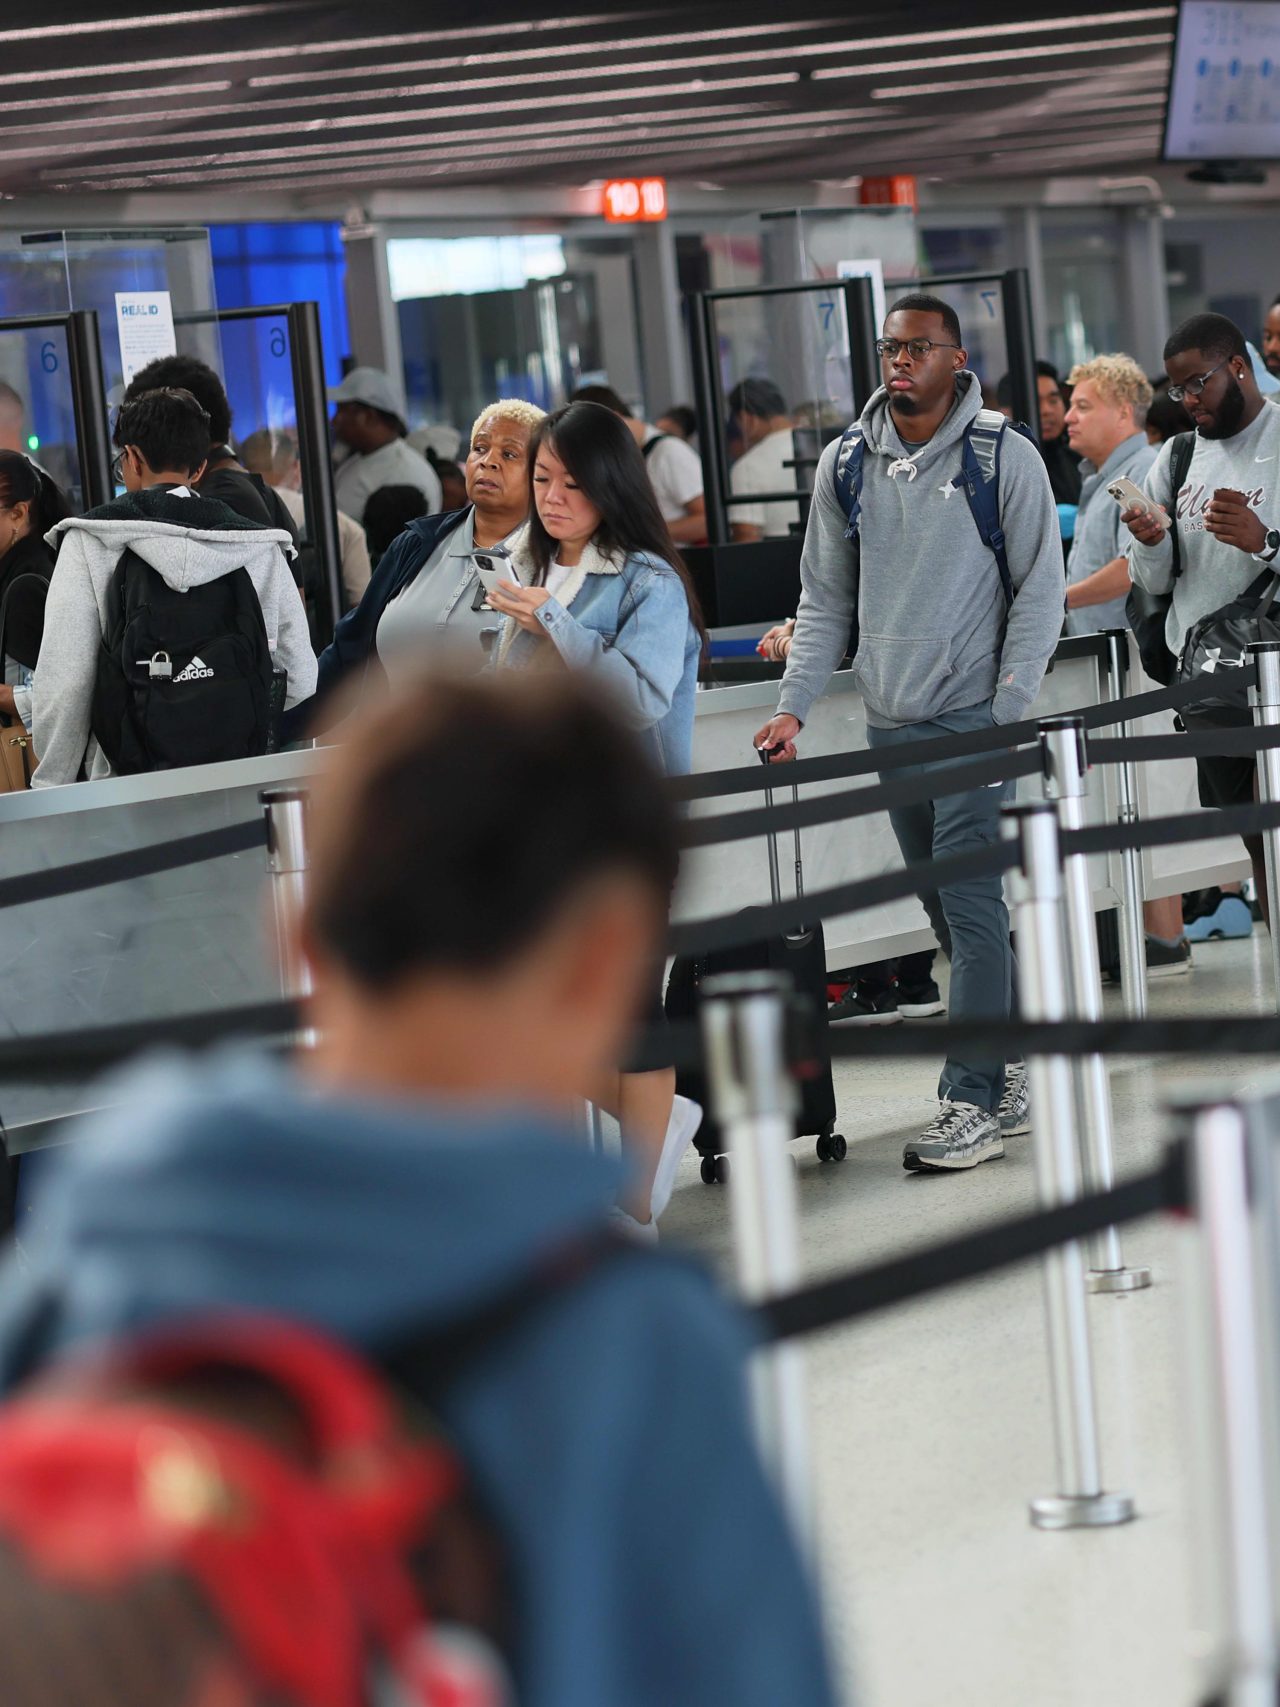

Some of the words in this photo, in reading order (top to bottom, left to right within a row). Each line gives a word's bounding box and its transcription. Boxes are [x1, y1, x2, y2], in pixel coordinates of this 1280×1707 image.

[606, 182, 639, 217] 10
[122, 305, 148, 316] REAL
[148, 304, 159, 315] ID
[819, 302, 835, 330] 7
[41, 341, 58, 373] 6
[173, 667, 215, 683] adidas
